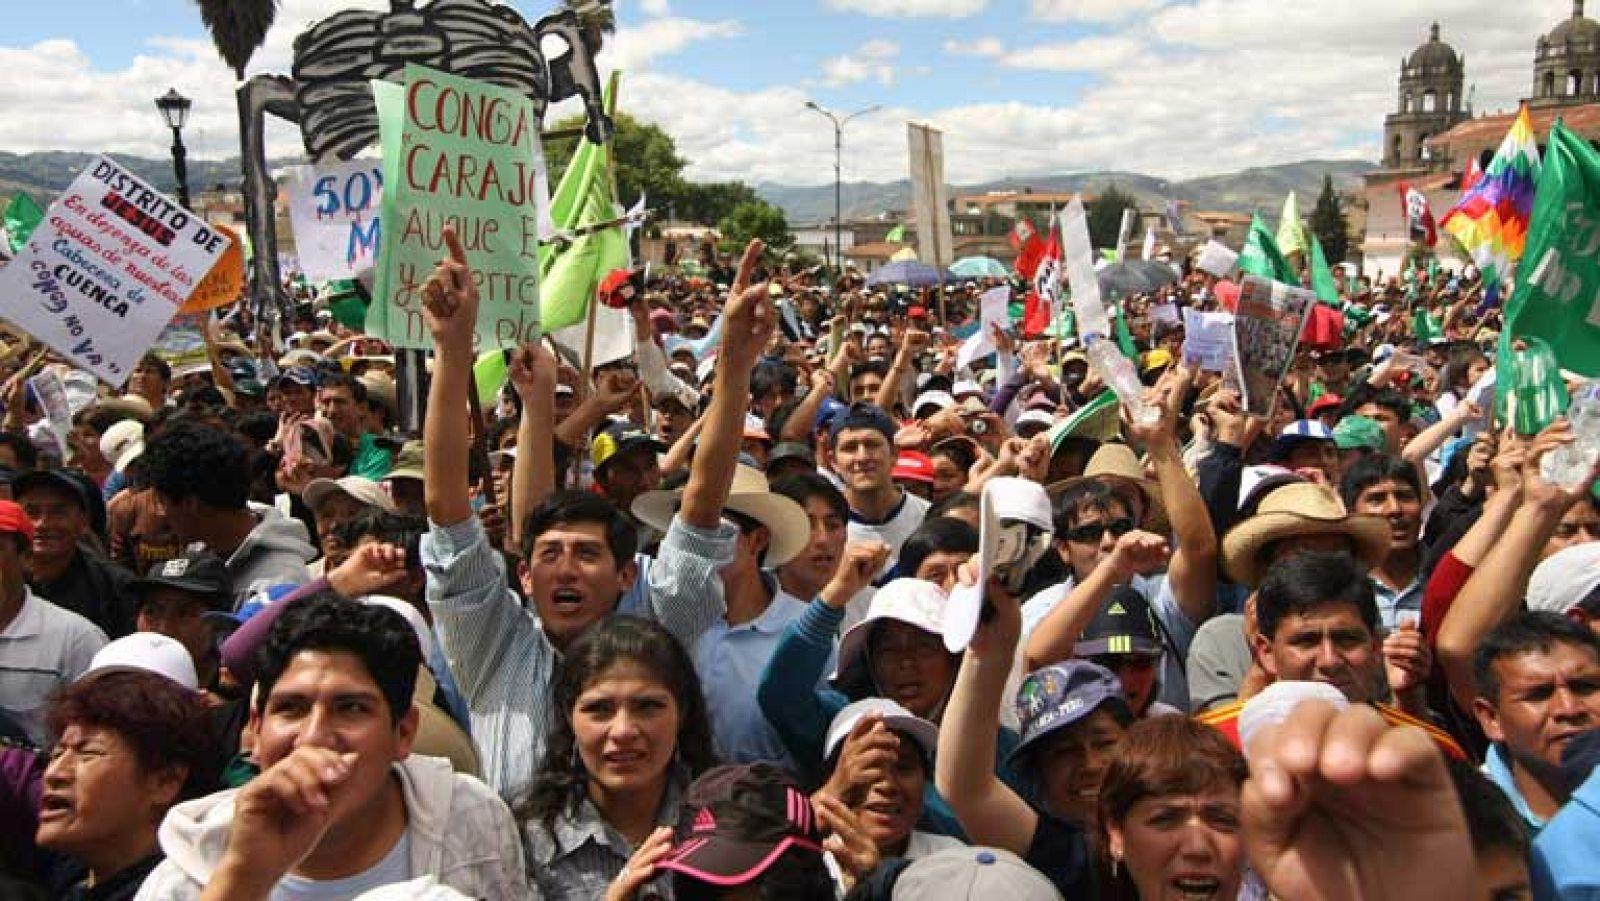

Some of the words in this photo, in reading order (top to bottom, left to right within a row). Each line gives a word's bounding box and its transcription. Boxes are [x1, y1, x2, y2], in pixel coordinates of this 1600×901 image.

[92, 161, 188, 230] DISTRITO
[192, 228, 224, 253] DE
[54, 264, 129, 318] CUENCA
